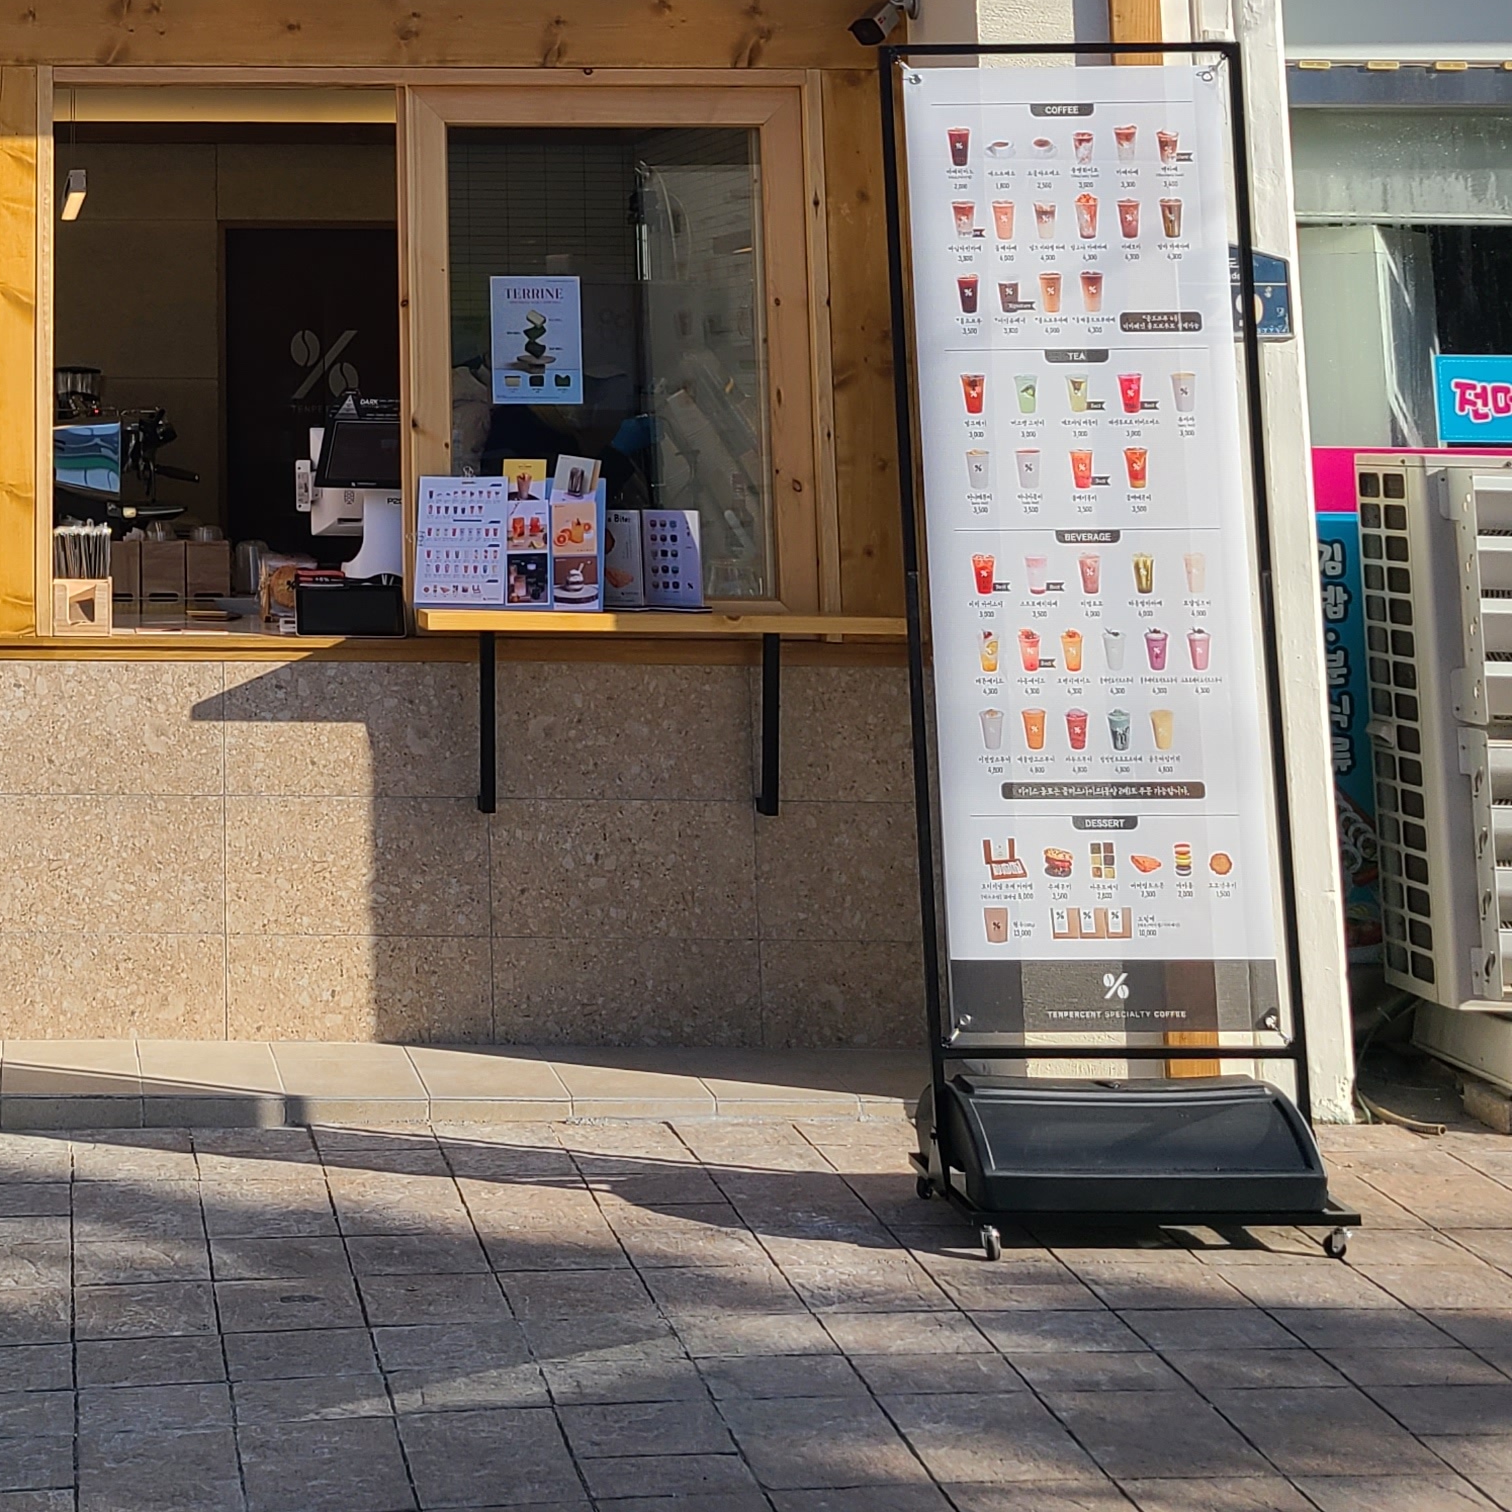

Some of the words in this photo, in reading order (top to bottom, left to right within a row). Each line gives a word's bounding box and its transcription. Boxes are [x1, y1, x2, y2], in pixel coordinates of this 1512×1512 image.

[1045, 106, 1079, 114] COFFEE
[506, 288, 563, 299] TERRINE
[1067, 352, 1086, 360] TEA
[1064, 533, 1111, 541] BEVERAGE
[1085, 819, 1125, 828] DESSERT
[1047, 1010, 1102, 1019] TENPERCENT
[1104, 1011, 1151, 1019] SPECIALTY
[1154, 1010, 1186, 1019] COFFEE
